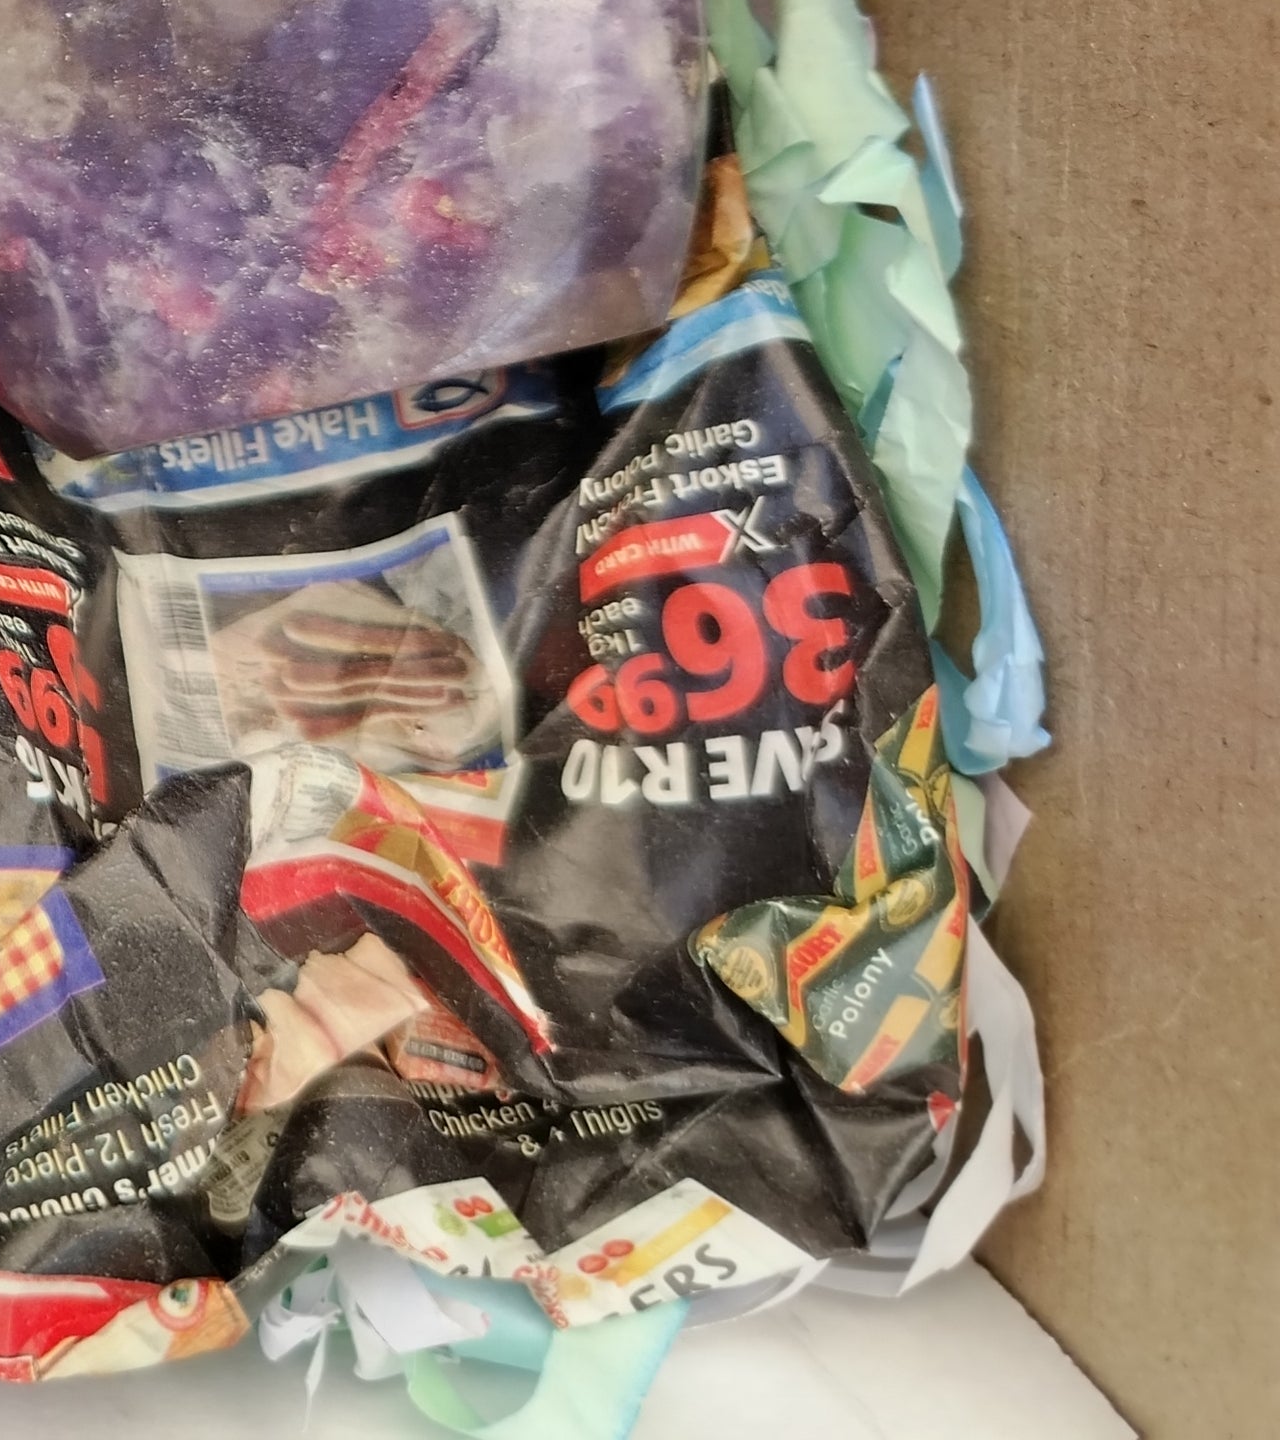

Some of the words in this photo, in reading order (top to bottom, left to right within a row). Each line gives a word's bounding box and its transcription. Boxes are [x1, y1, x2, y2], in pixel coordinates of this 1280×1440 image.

[158, 426, 272, 473] Fillets
[272, 401, 381, 452] Hake
[664, 419, 761, 458] Garlic
[579, 444, 661, 508] Polony
[669, 454, 787, 499] Eskort
[594, 543, 643, 576] CARD
[646, 532, 703, 556] WITH
[17, 576, 63, 601] WITH
[578, 596, 642, 638] each
[589, 628, 644, 660] 1kg
[561, 737, 693, 805] R10
[828, 945, 896, 1041] Polony
[85, 1053, 203, 1111] Chicken
[4, 1100, 83, 1161] Fillets
[140, 1091, 228, 1152] Fresh
[427, 1100, 536, 1139] Chicken
[4, 1127, 136, 1189] 12-Piece
